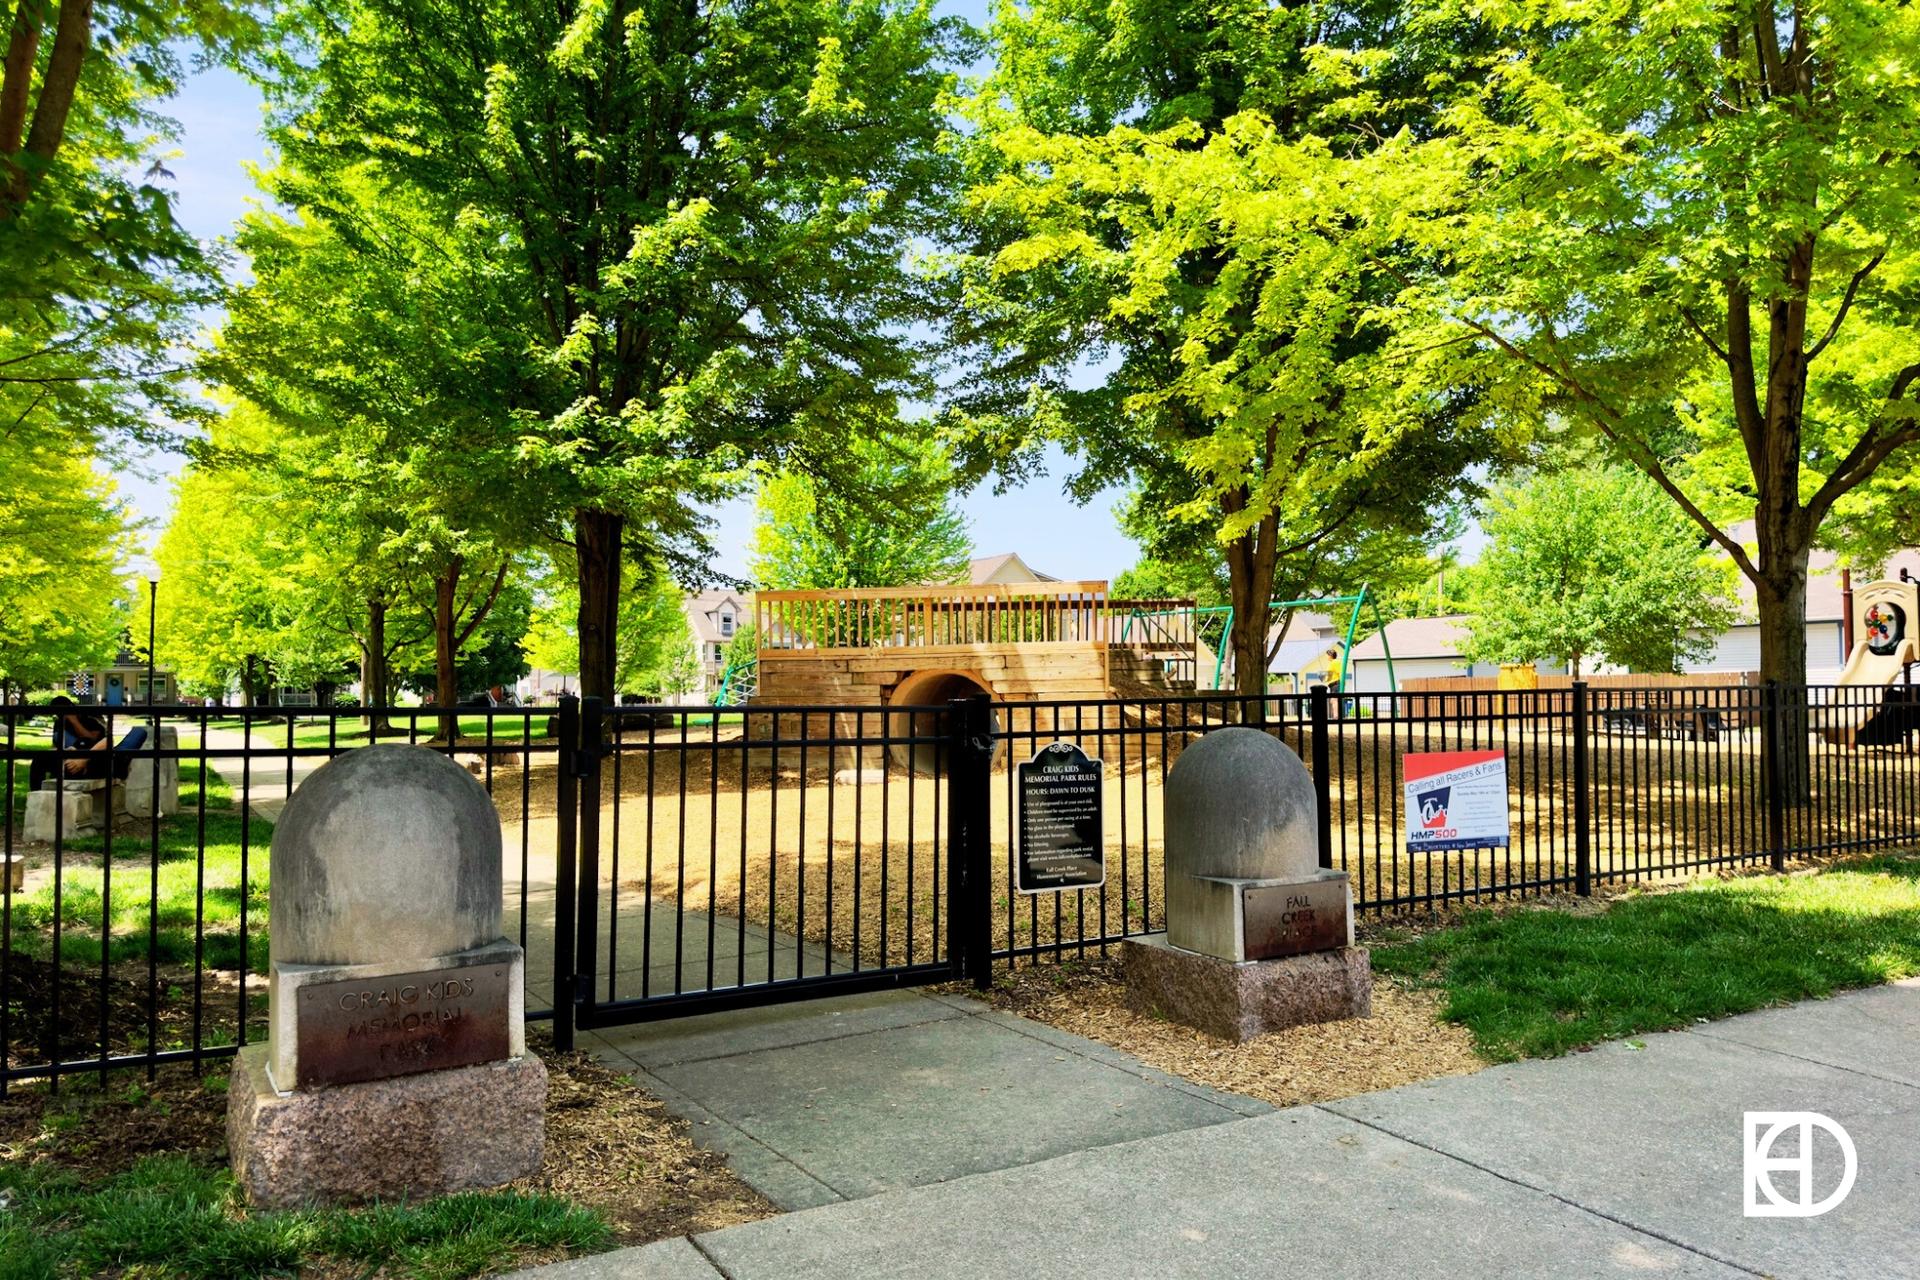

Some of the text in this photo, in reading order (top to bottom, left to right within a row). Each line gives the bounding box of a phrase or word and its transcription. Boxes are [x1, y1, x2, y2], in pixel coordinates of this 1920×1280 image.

[1408, 762, 1502, 793] Calling all Racers & Fans
[1411, 829, 1457, 840] HMP500
[1287, 896, 1311, 909] FALL
[1282, 910, 1315, 924] CREEK
[339, 977, 474, 1011] CRAIG KIDS
[347, 1007, 462, 1041] MEMORIAL
